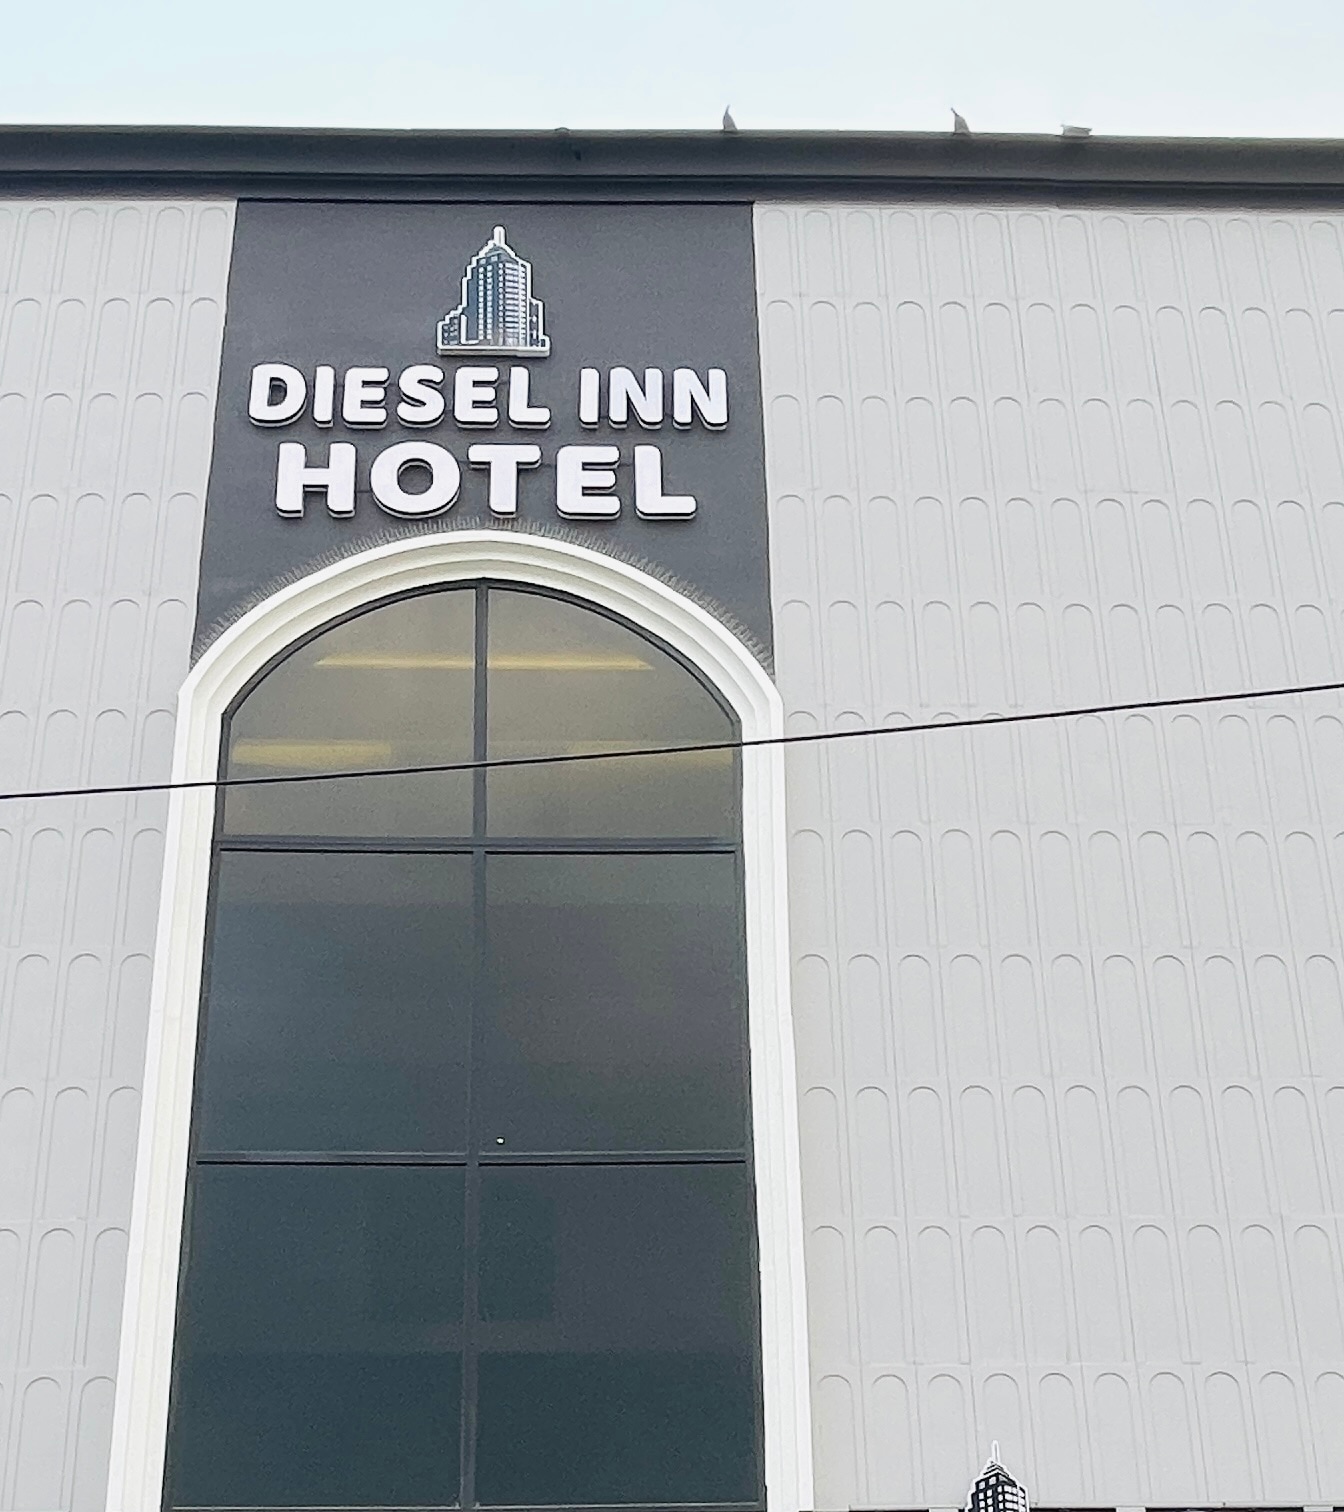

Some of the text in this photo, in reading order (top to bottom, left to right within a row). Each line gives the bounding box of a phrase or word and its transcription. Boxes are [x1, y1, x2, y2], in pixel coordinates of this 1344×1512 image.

[248, 363, 728, 429] DIESEL INN
[275, 441, 697, 520] HOTEL
